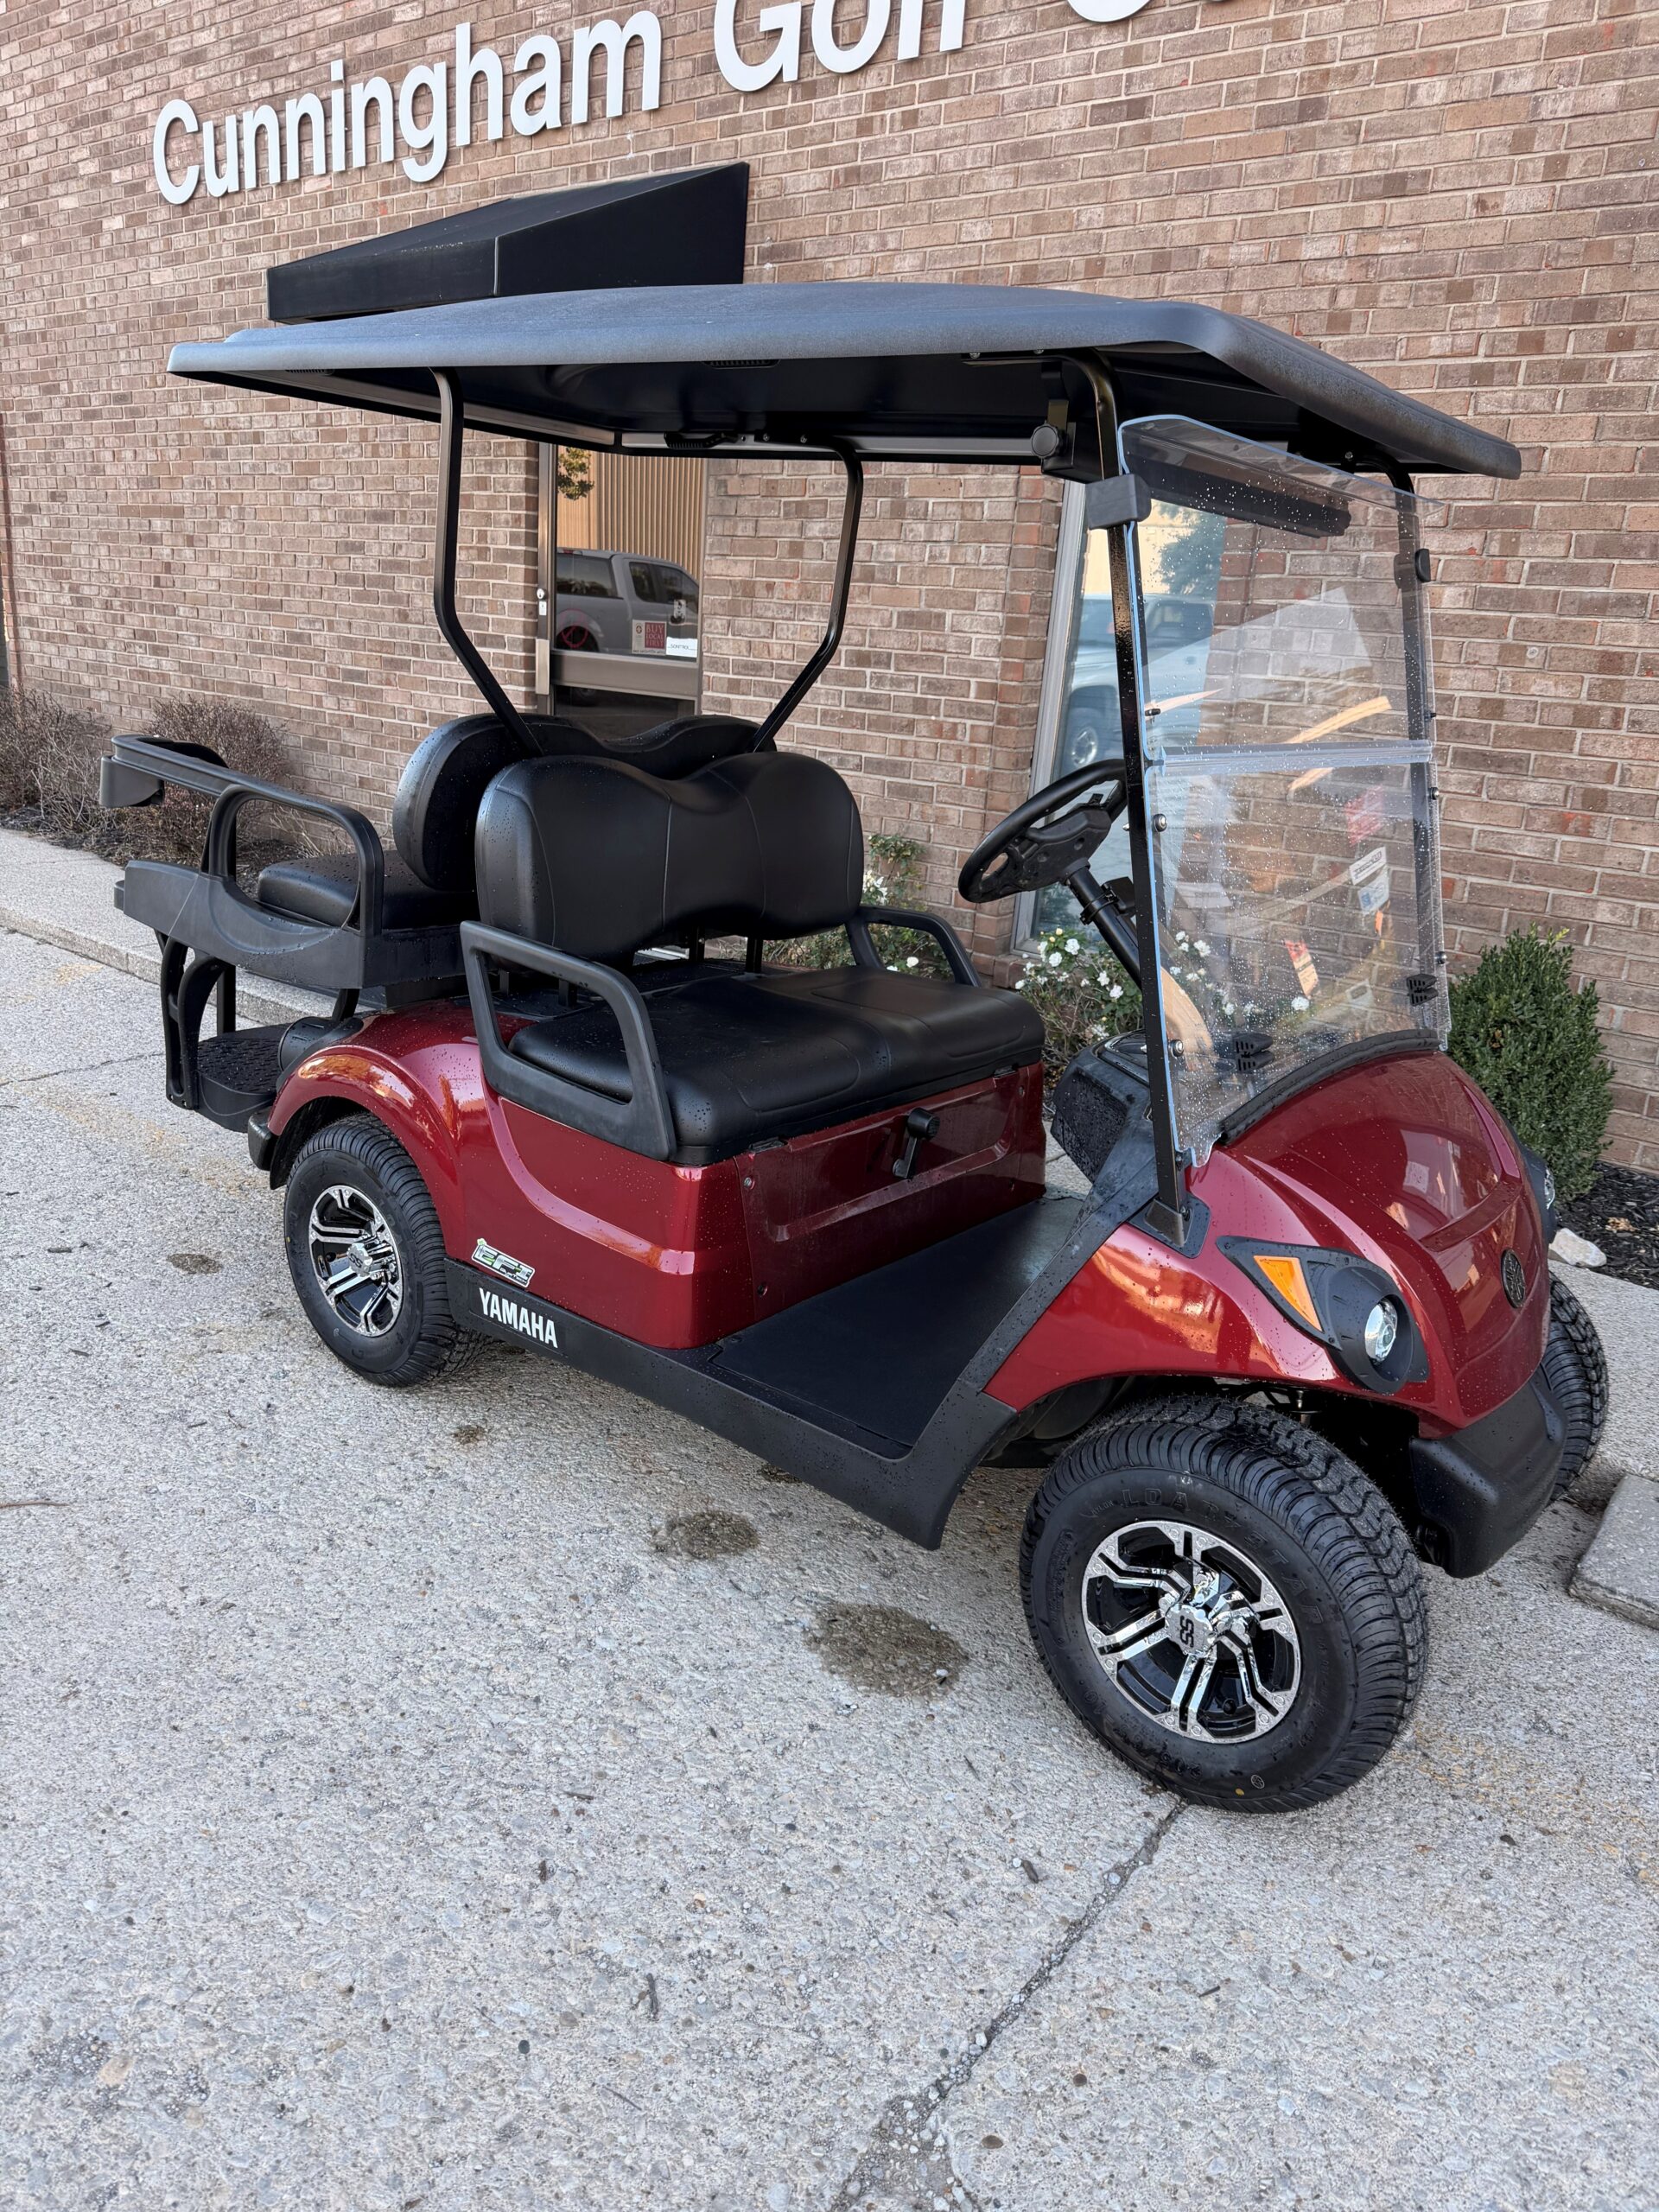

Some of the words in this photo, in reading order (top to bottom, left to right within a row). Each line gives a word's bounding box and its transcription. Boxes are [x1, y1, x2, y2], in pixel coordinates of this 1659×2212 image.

[153, 10, 662, 205] Cunningham
[646, 624, 664, 633] BUY
[474, 1244, 533, 1281] EFI
[479, 1287, 558, 1349] YAMAHA
